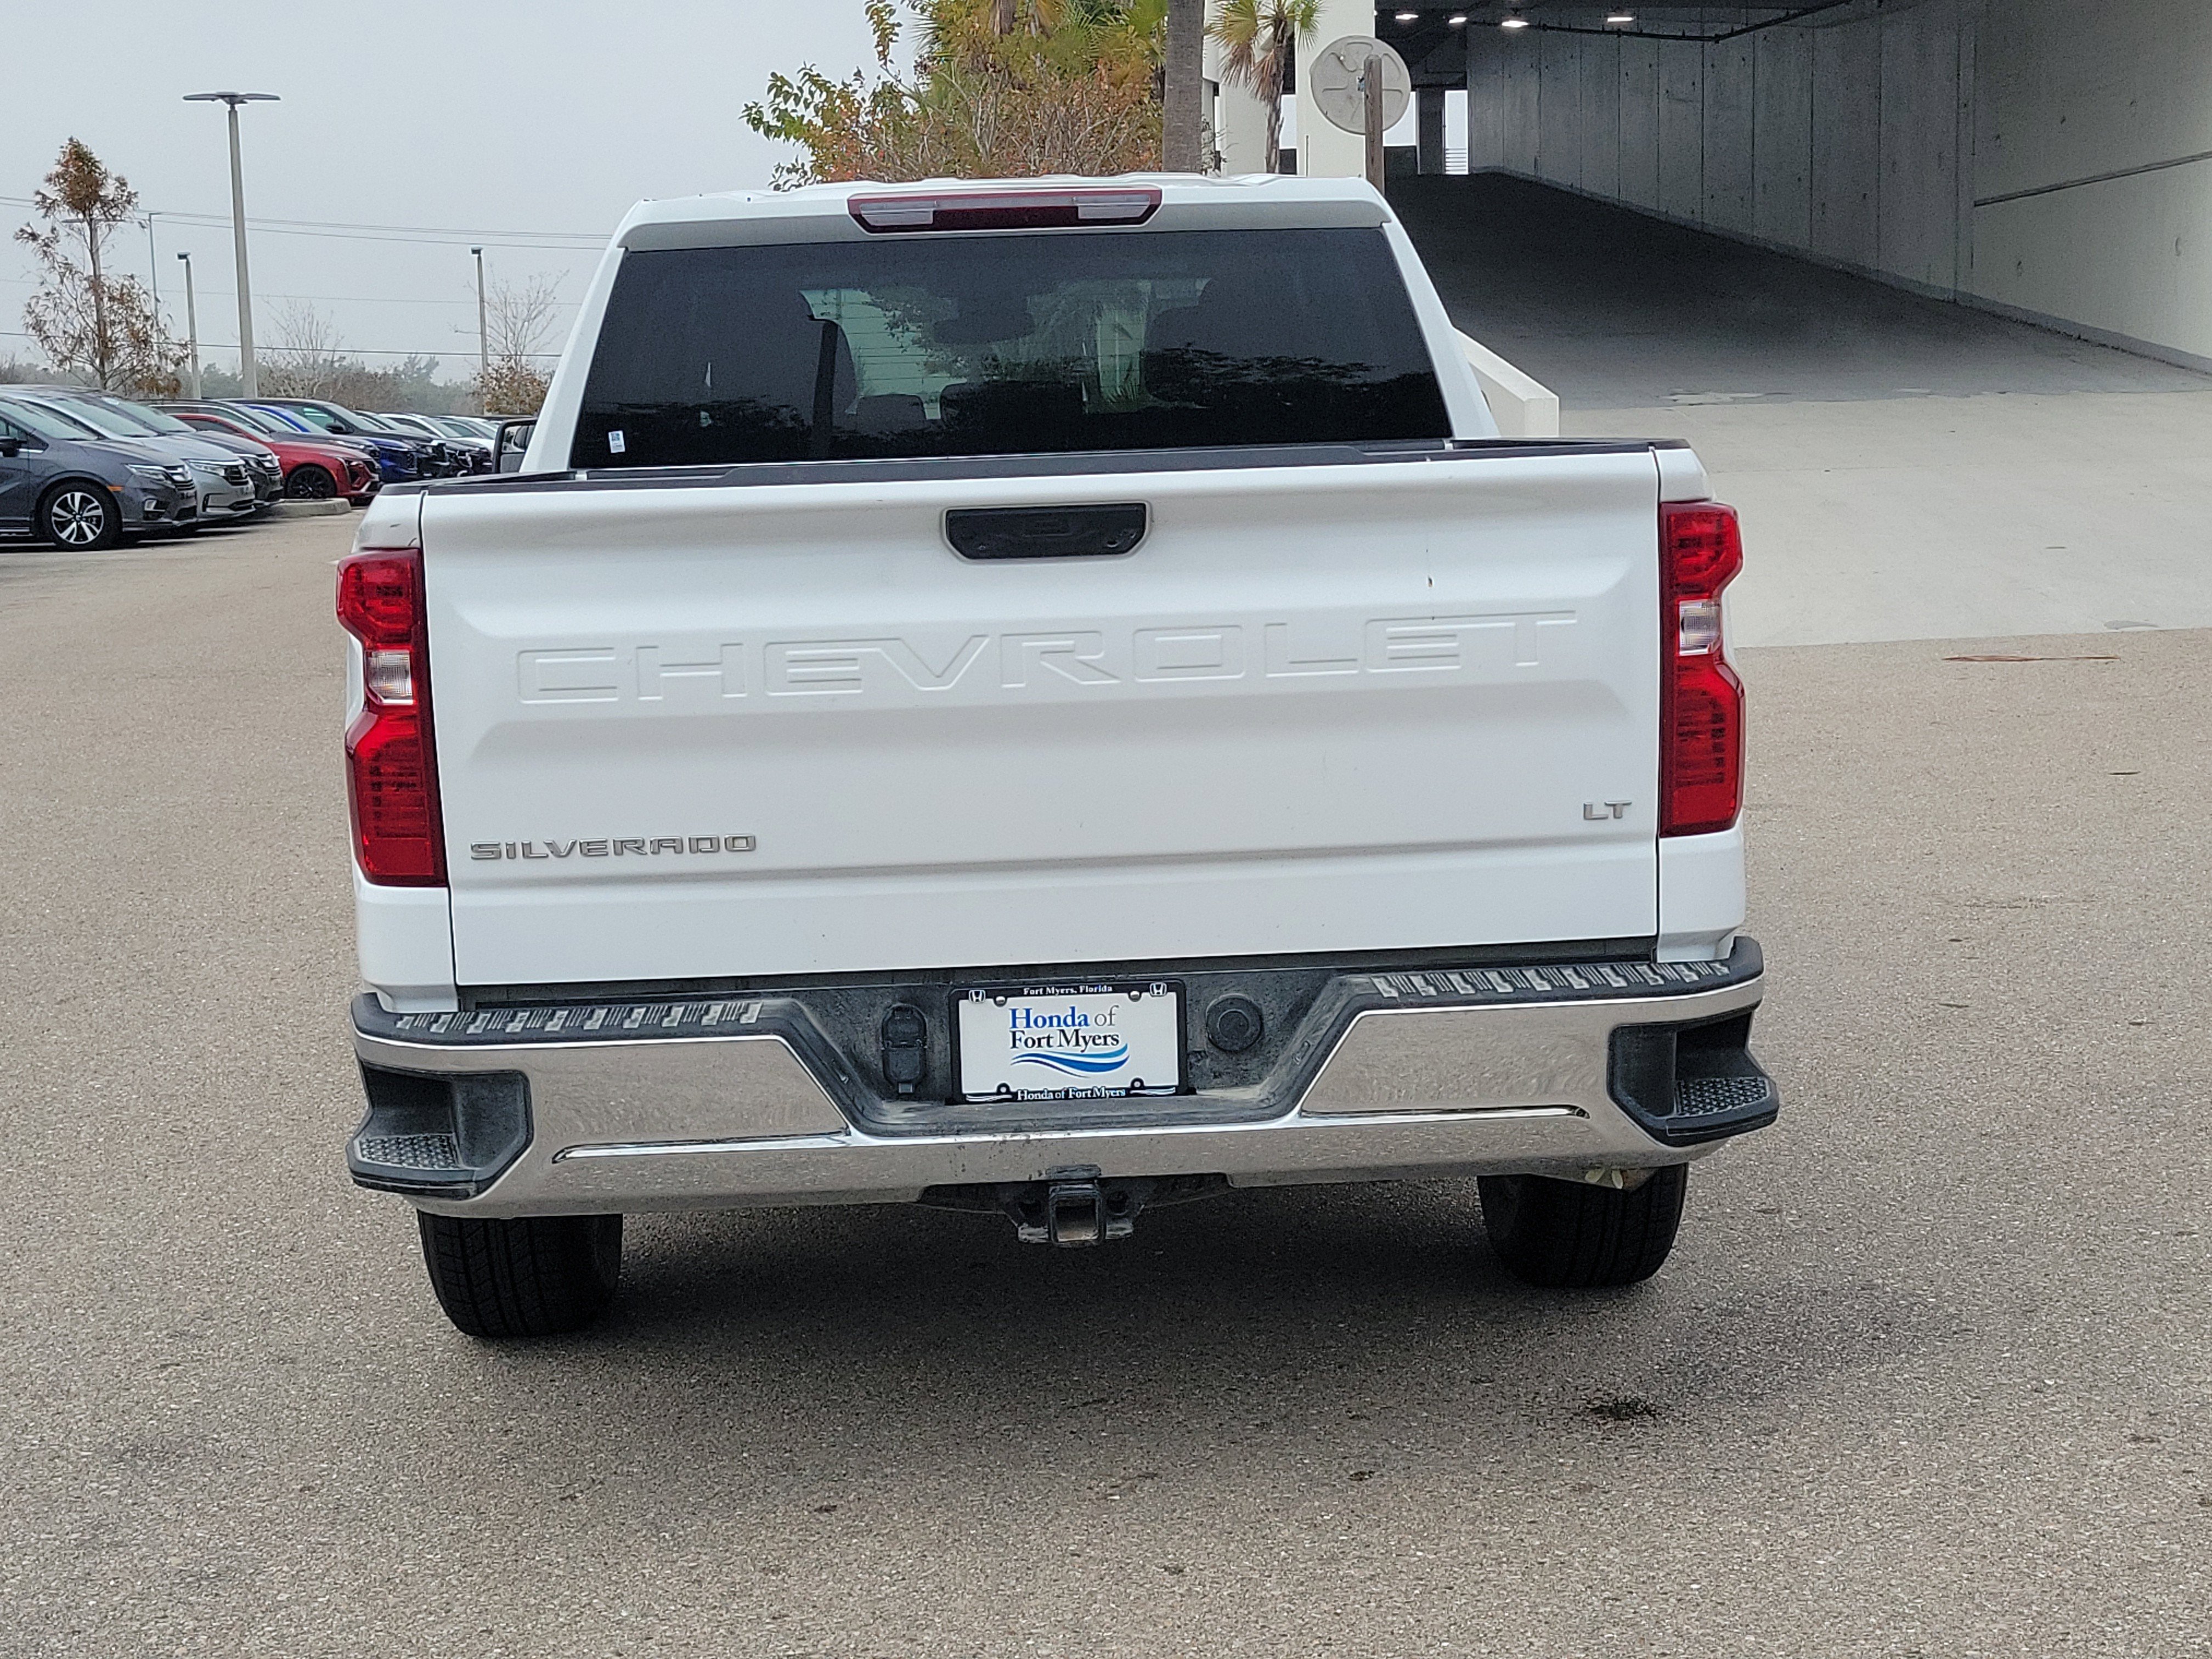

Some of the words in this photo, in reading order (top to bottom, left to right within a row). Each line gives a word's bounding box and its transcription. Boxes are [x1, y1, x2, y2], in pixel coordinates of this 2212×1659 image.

[517, 610, 1577, 704] CHEVROLET
[1583, 800, 1632, 820] LT
[470, 833, 757, 861] SILVERADO
[1023, 987, 1043, 995] Fort
[1079, 985, 1113, 993] Florida
[1008, 1005, 1091, 1029] Honda
[1094, 1005, 1120, 1027] of
[1009, 1029, 1054, 1049] Fort
[1057, 1028, 1120, 1053] Myers
[1017, 1088, 1054, 1101] Honda
[1055, 1088, 1067, 1099] of
[1068, 1088, 1092, 1099] Fort
[1092, 1086, 1126, 1099] Myers
